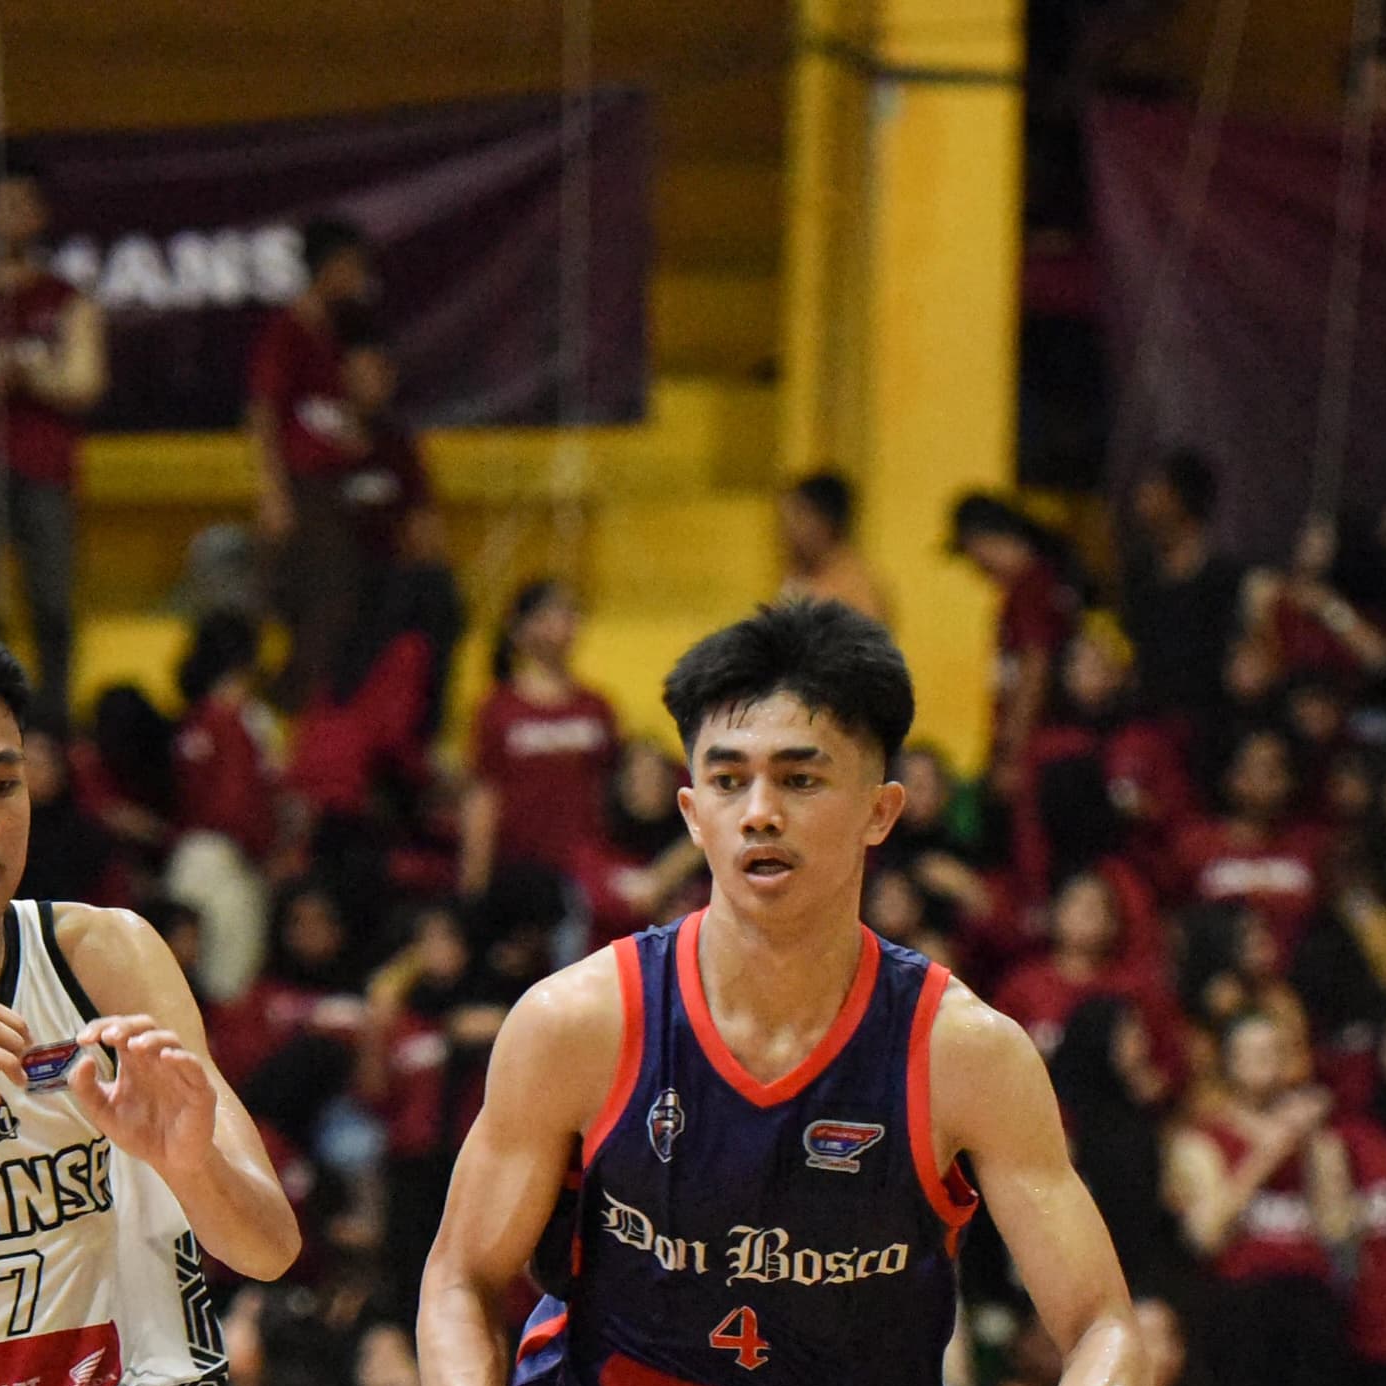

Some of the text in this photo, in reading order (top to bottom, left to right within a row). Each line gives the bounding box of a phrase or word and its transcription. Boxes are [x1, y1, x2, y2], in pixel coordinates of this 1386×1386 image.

[601, 1189, 909, 1287] Don Bosco
[709, 1305, 771, 1371] 4
